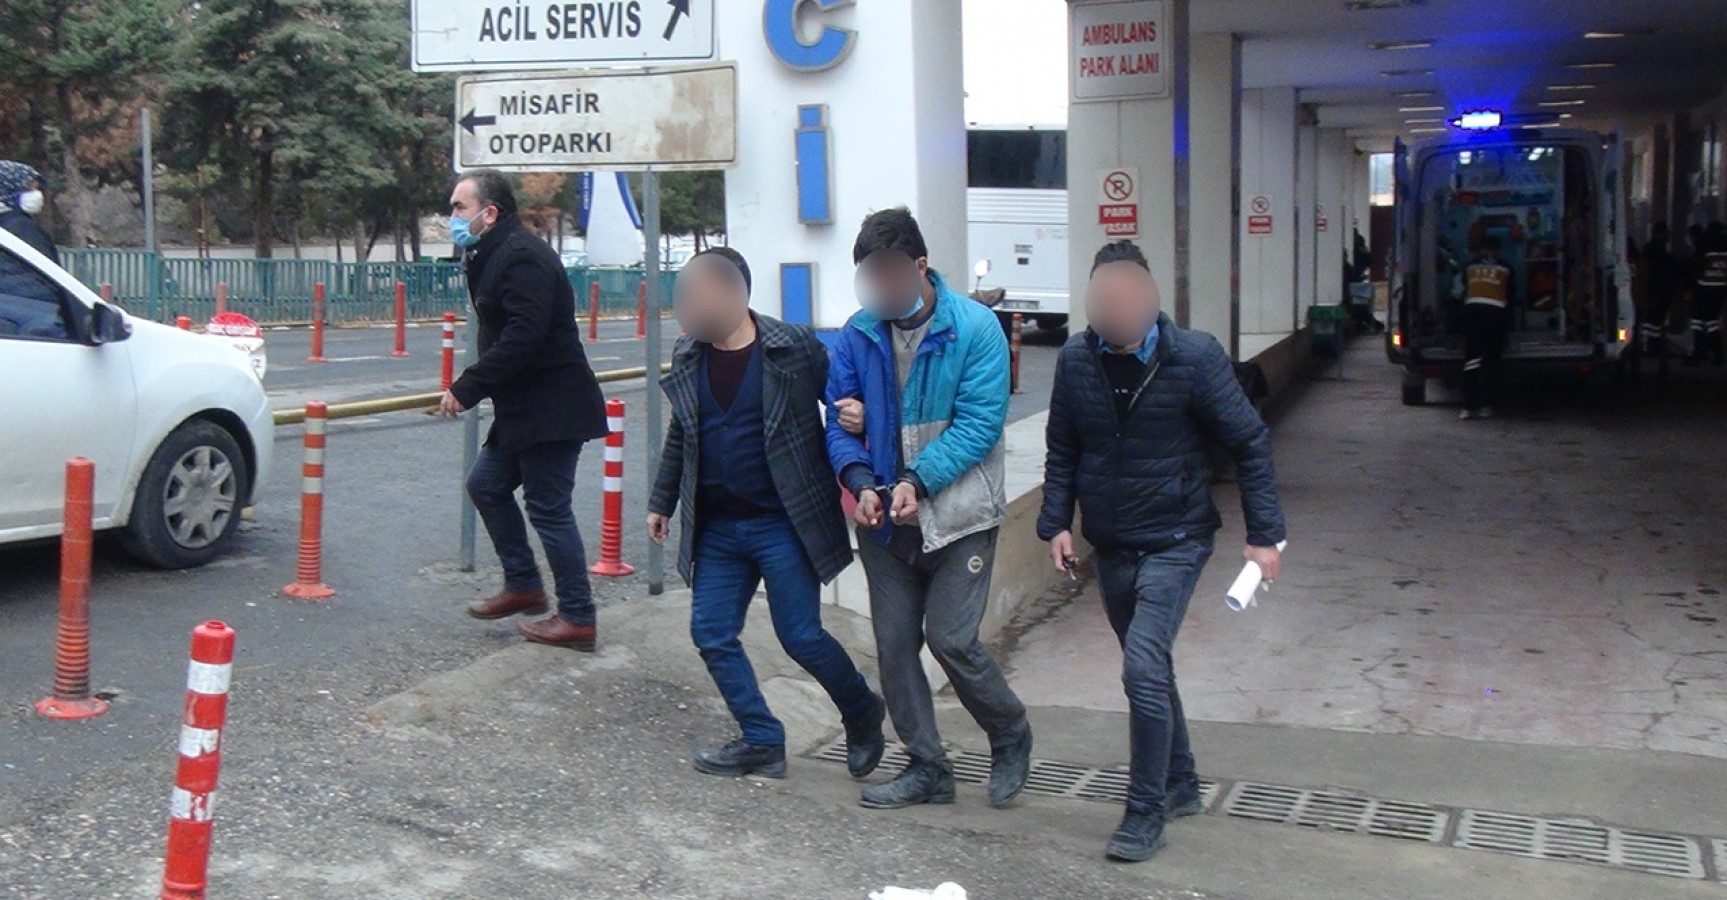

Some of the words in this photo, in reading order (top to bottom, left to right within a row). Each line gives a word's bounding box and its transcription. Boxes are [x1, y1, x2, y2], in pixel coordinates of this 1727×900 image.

[1082, 22, 1157, 45] AMBULANS
[1080, 55, 1115, 77] PARK
[1119, 53, 1160, 75] ALANI
[499, 89, 600, 116] MİSAFİR
[489, 132, 612, 154] OTOPARKI
[1103, 206, 1133, 218] PARK
